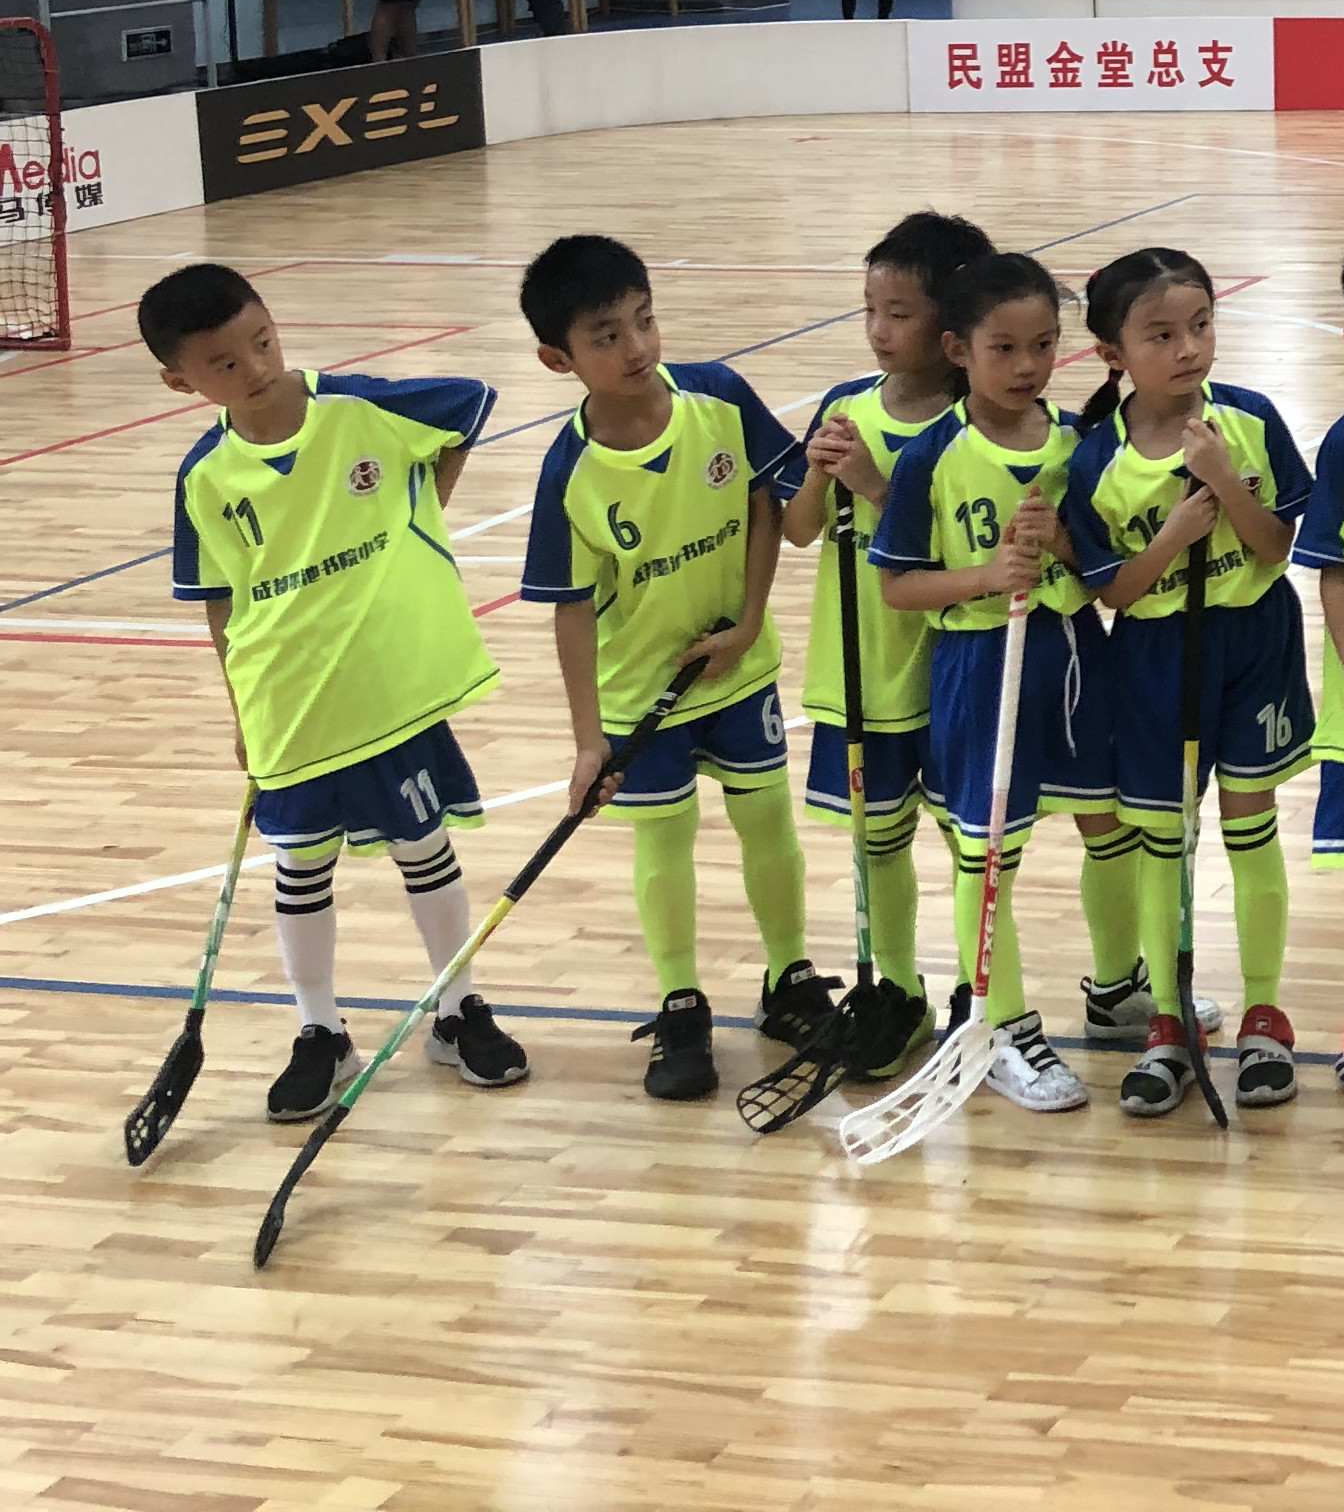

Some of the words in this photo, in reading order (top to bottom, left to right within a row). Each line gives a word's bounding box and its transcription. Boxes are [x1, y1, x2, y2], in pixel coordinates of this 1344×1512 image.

[946, 39, 1235, 89] 民盟金堂总支
[237, 84, 458, 163] EXEL
[222, 497, 264, 547] 11
[608, 501, 642, 550] 6
[955, 497, 999, 553] 13
[763, 693, 783, 745] 6
[1257, 705, 1291, 753] 16
[401, 768, 441, 823] 11
